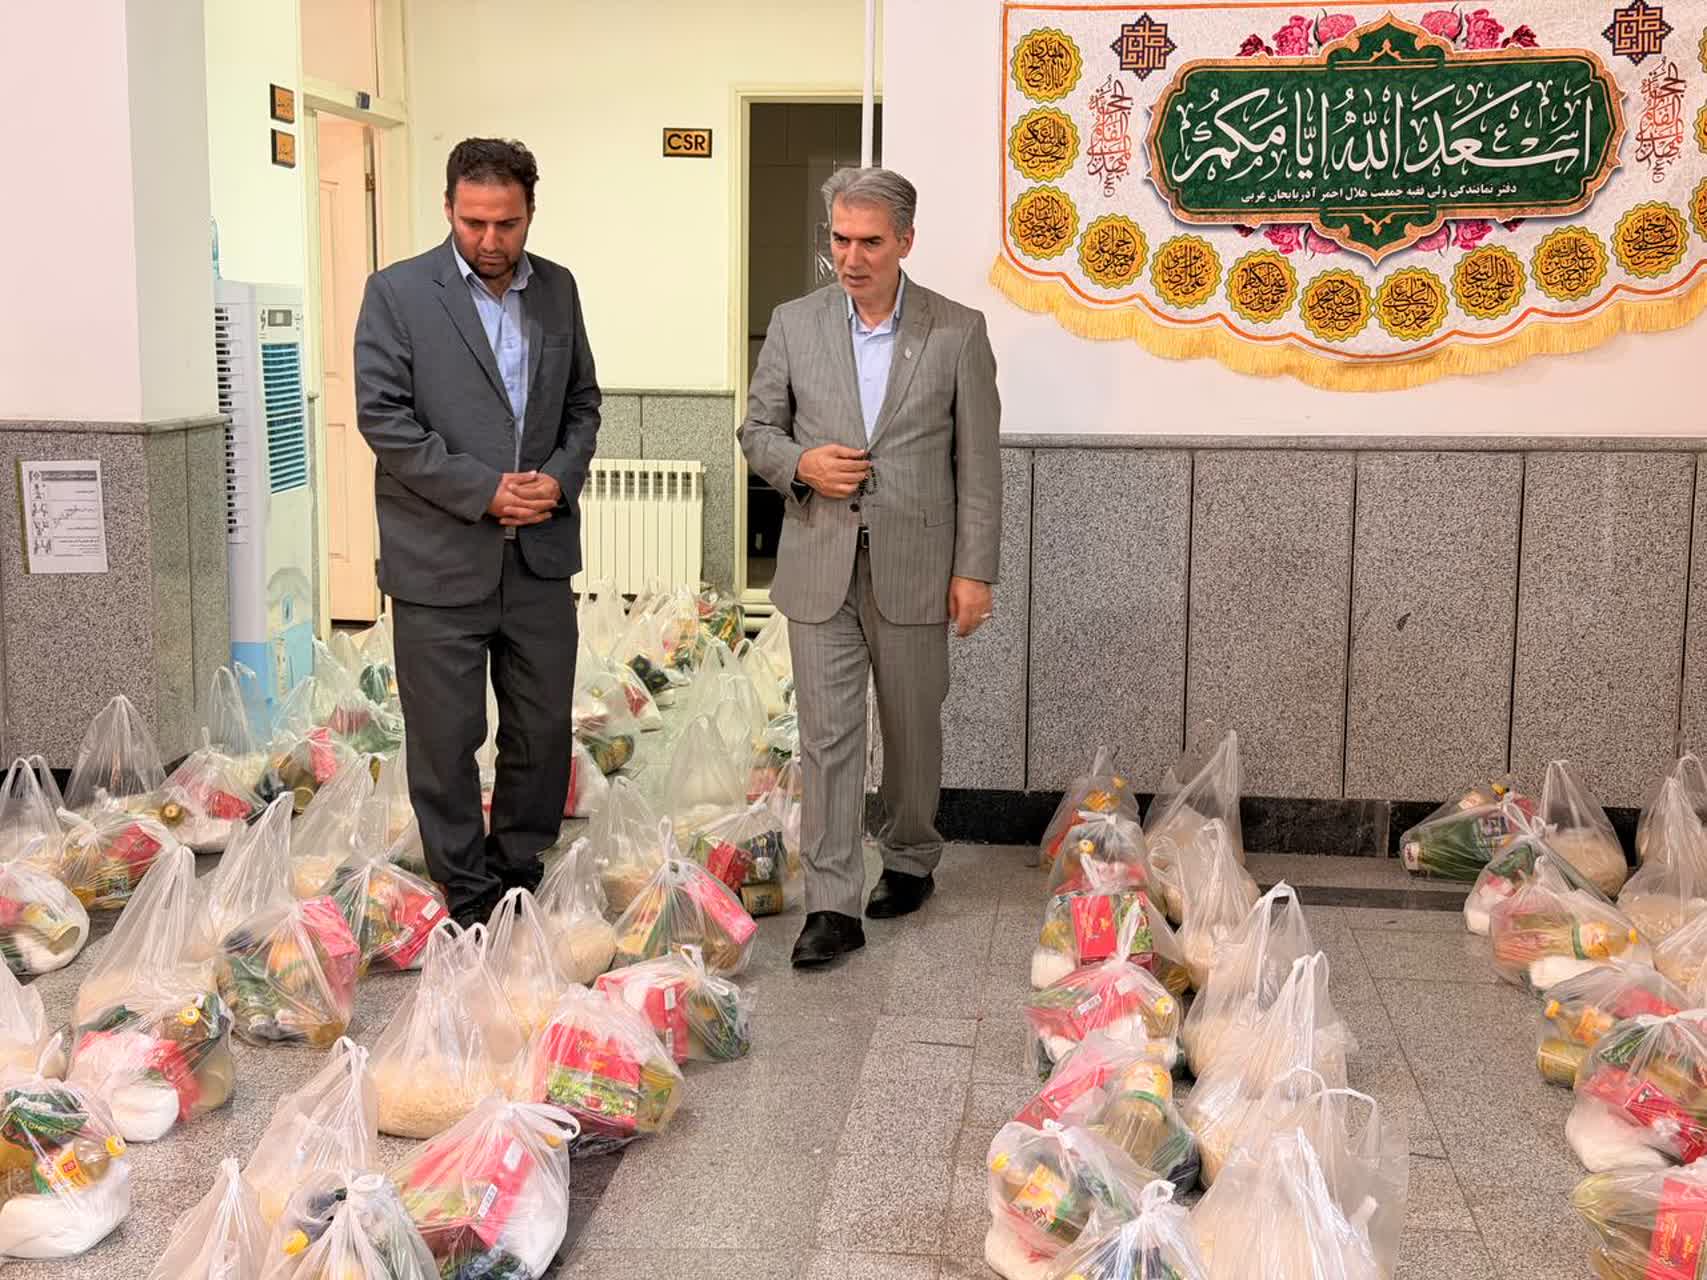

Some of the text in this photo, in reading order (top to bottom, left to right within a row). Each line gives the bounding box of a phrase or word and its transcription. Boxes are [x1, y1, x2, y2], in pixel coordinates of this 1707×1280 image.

[667, 133, 706, 151] CSR
[1241, 183, 1517, 203] دفتر نمایندگی ولی فقیه جمعیت هلال احمر آذربایجان غربی
